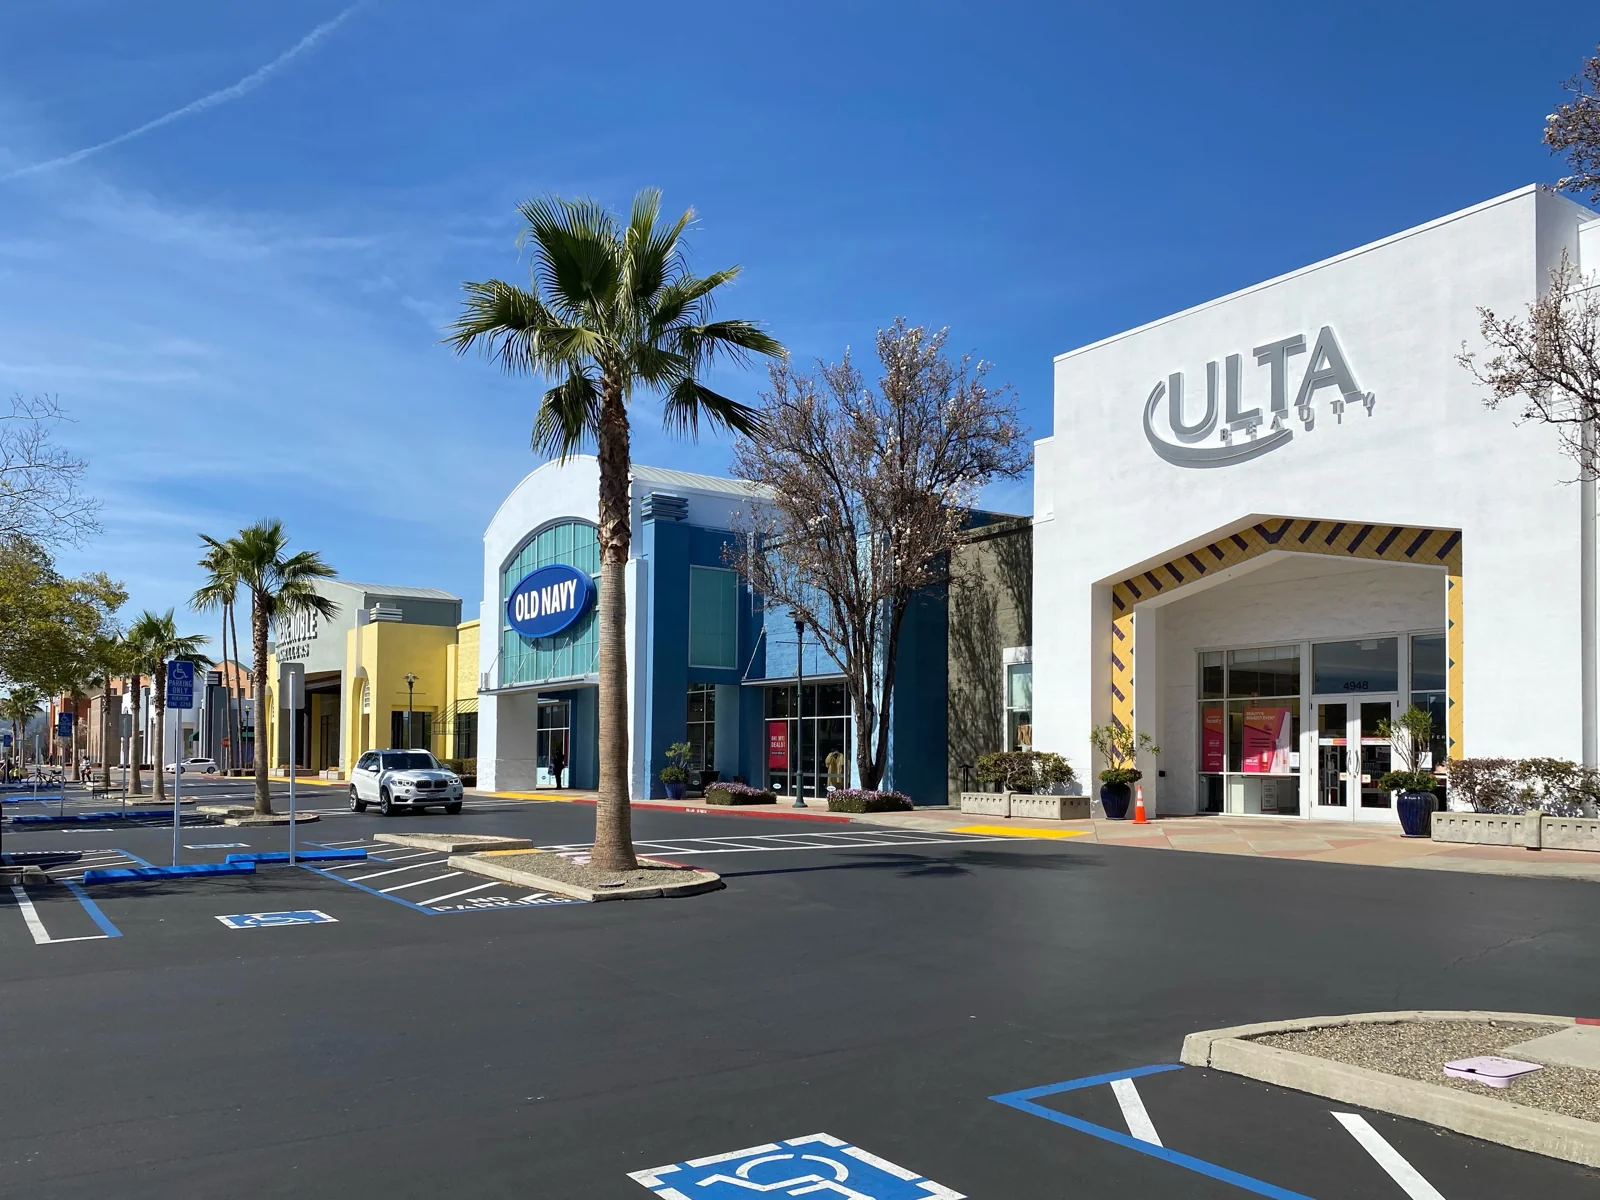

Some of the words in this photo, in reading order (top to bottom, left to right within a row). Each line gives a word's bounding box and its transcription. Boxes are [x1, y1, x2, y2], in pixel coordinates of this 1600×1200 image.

[1169, 325, 1362, 436] ULTA
[1220, 391, 1375, 442] BEAUTY
[515, 590, 540, 622] OLD
[541, 578, 577, 616] NAVY
[1343, 681, 1369, 691] 4948
